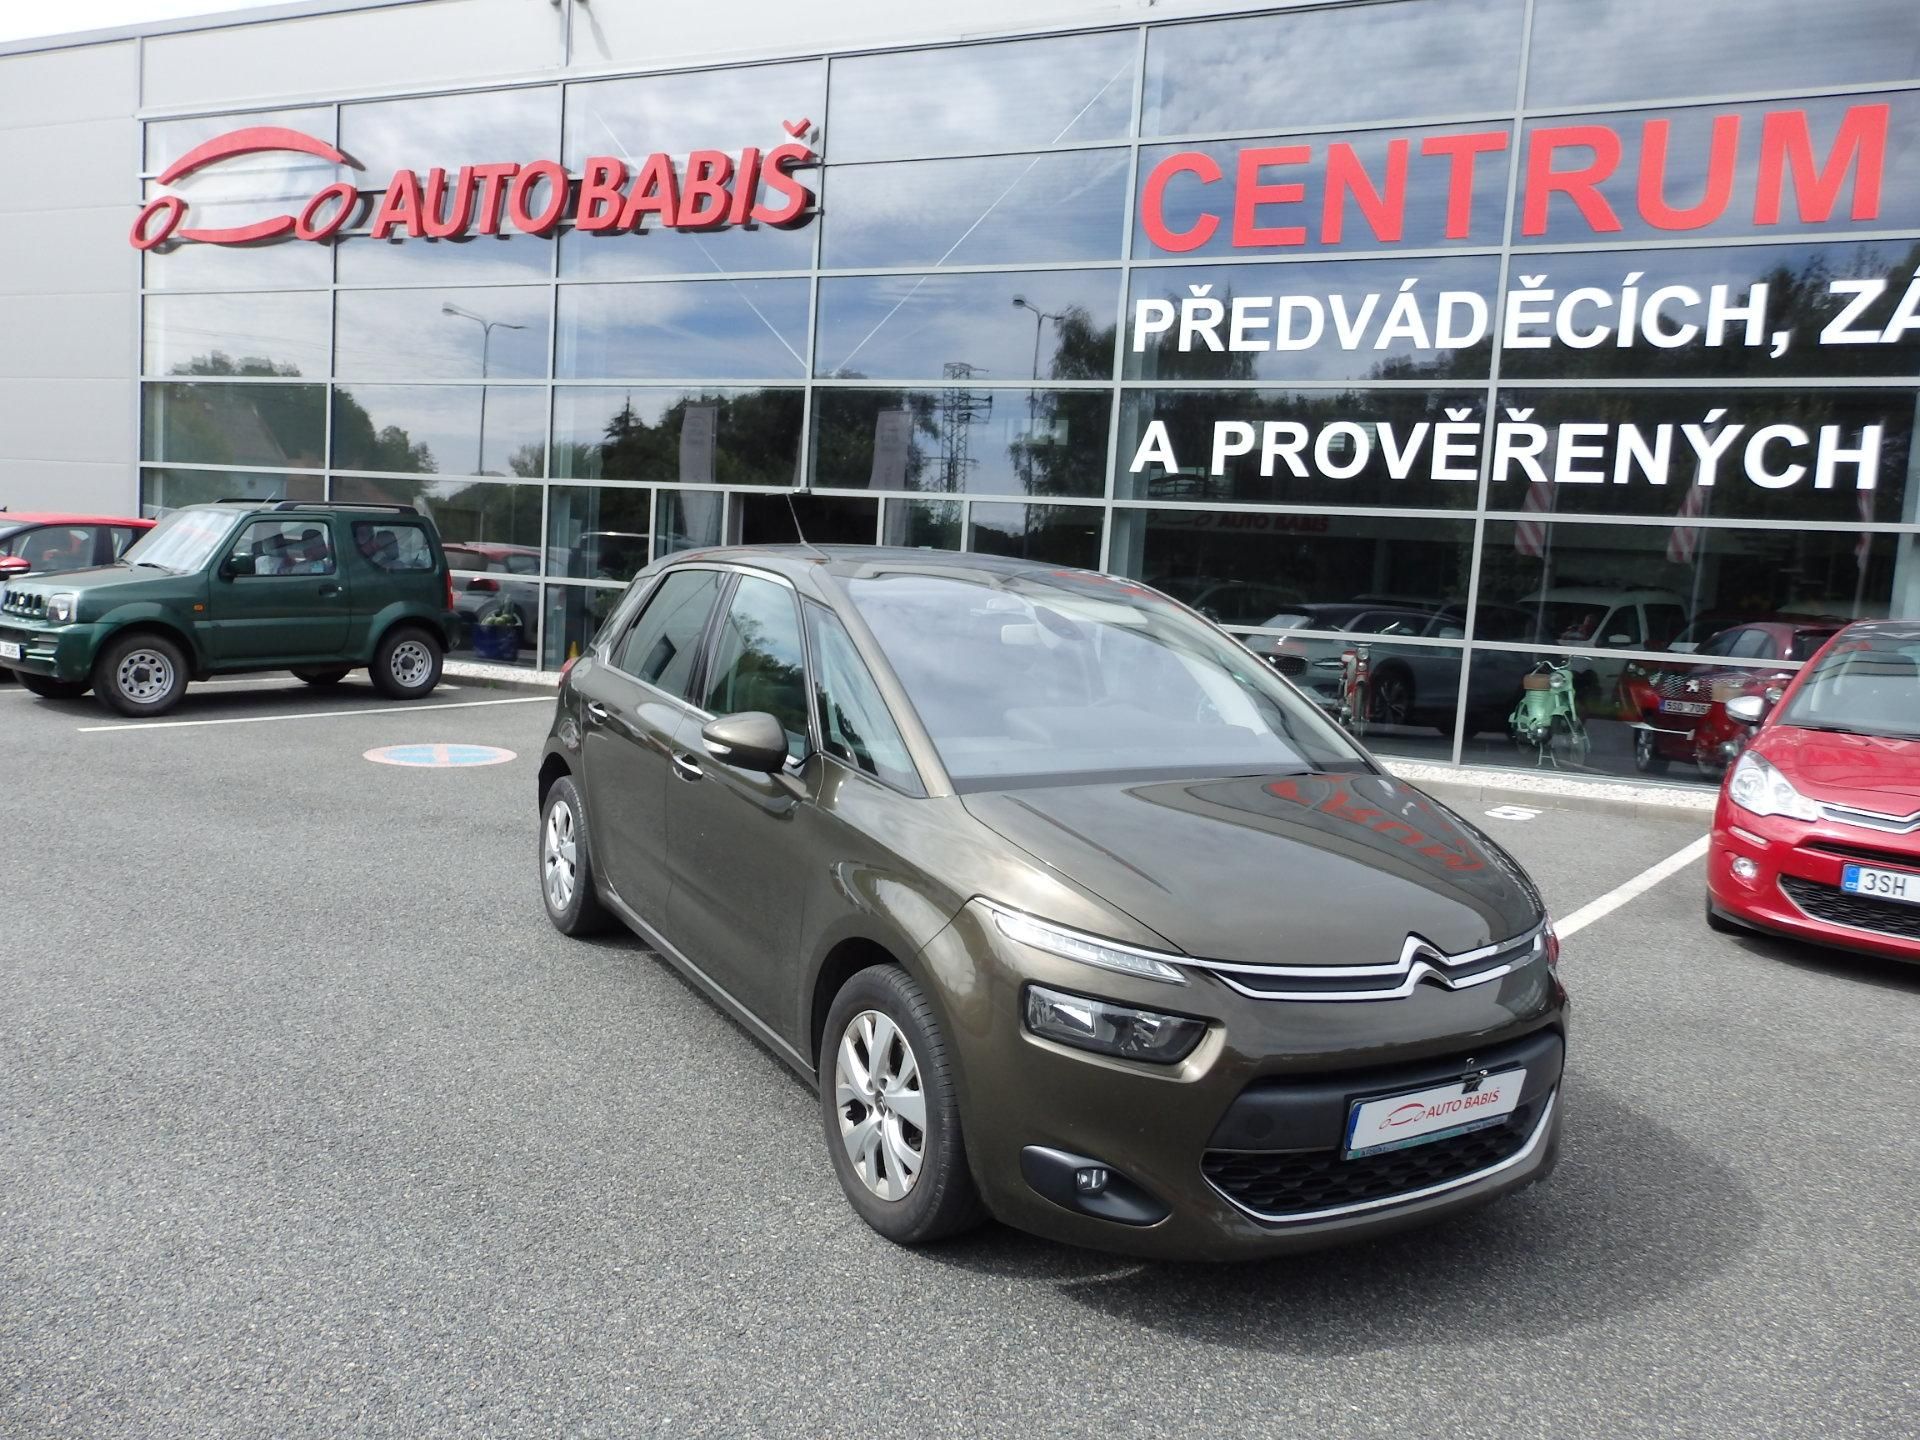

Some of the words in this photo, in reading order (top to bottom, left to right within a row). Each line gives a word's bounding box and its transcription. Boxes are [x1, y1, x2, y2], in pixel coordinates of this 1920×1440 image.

[371, 159, 568, 240] AUTO
[576, 118, 817, 232] BABIŠ
[1140, 104, 1890, 252] CENTRUM
[1132, 271, 1790, 358] PŘEDVÁDĚCÍCH,
[1129, 420, 1179, 474] A
[1211, 408, 1882, 489] PROVĚŘENÝCH
[1864, 872, 1906, 896] 3SH
[1426, 1100, 1461, 1119] AUTO
